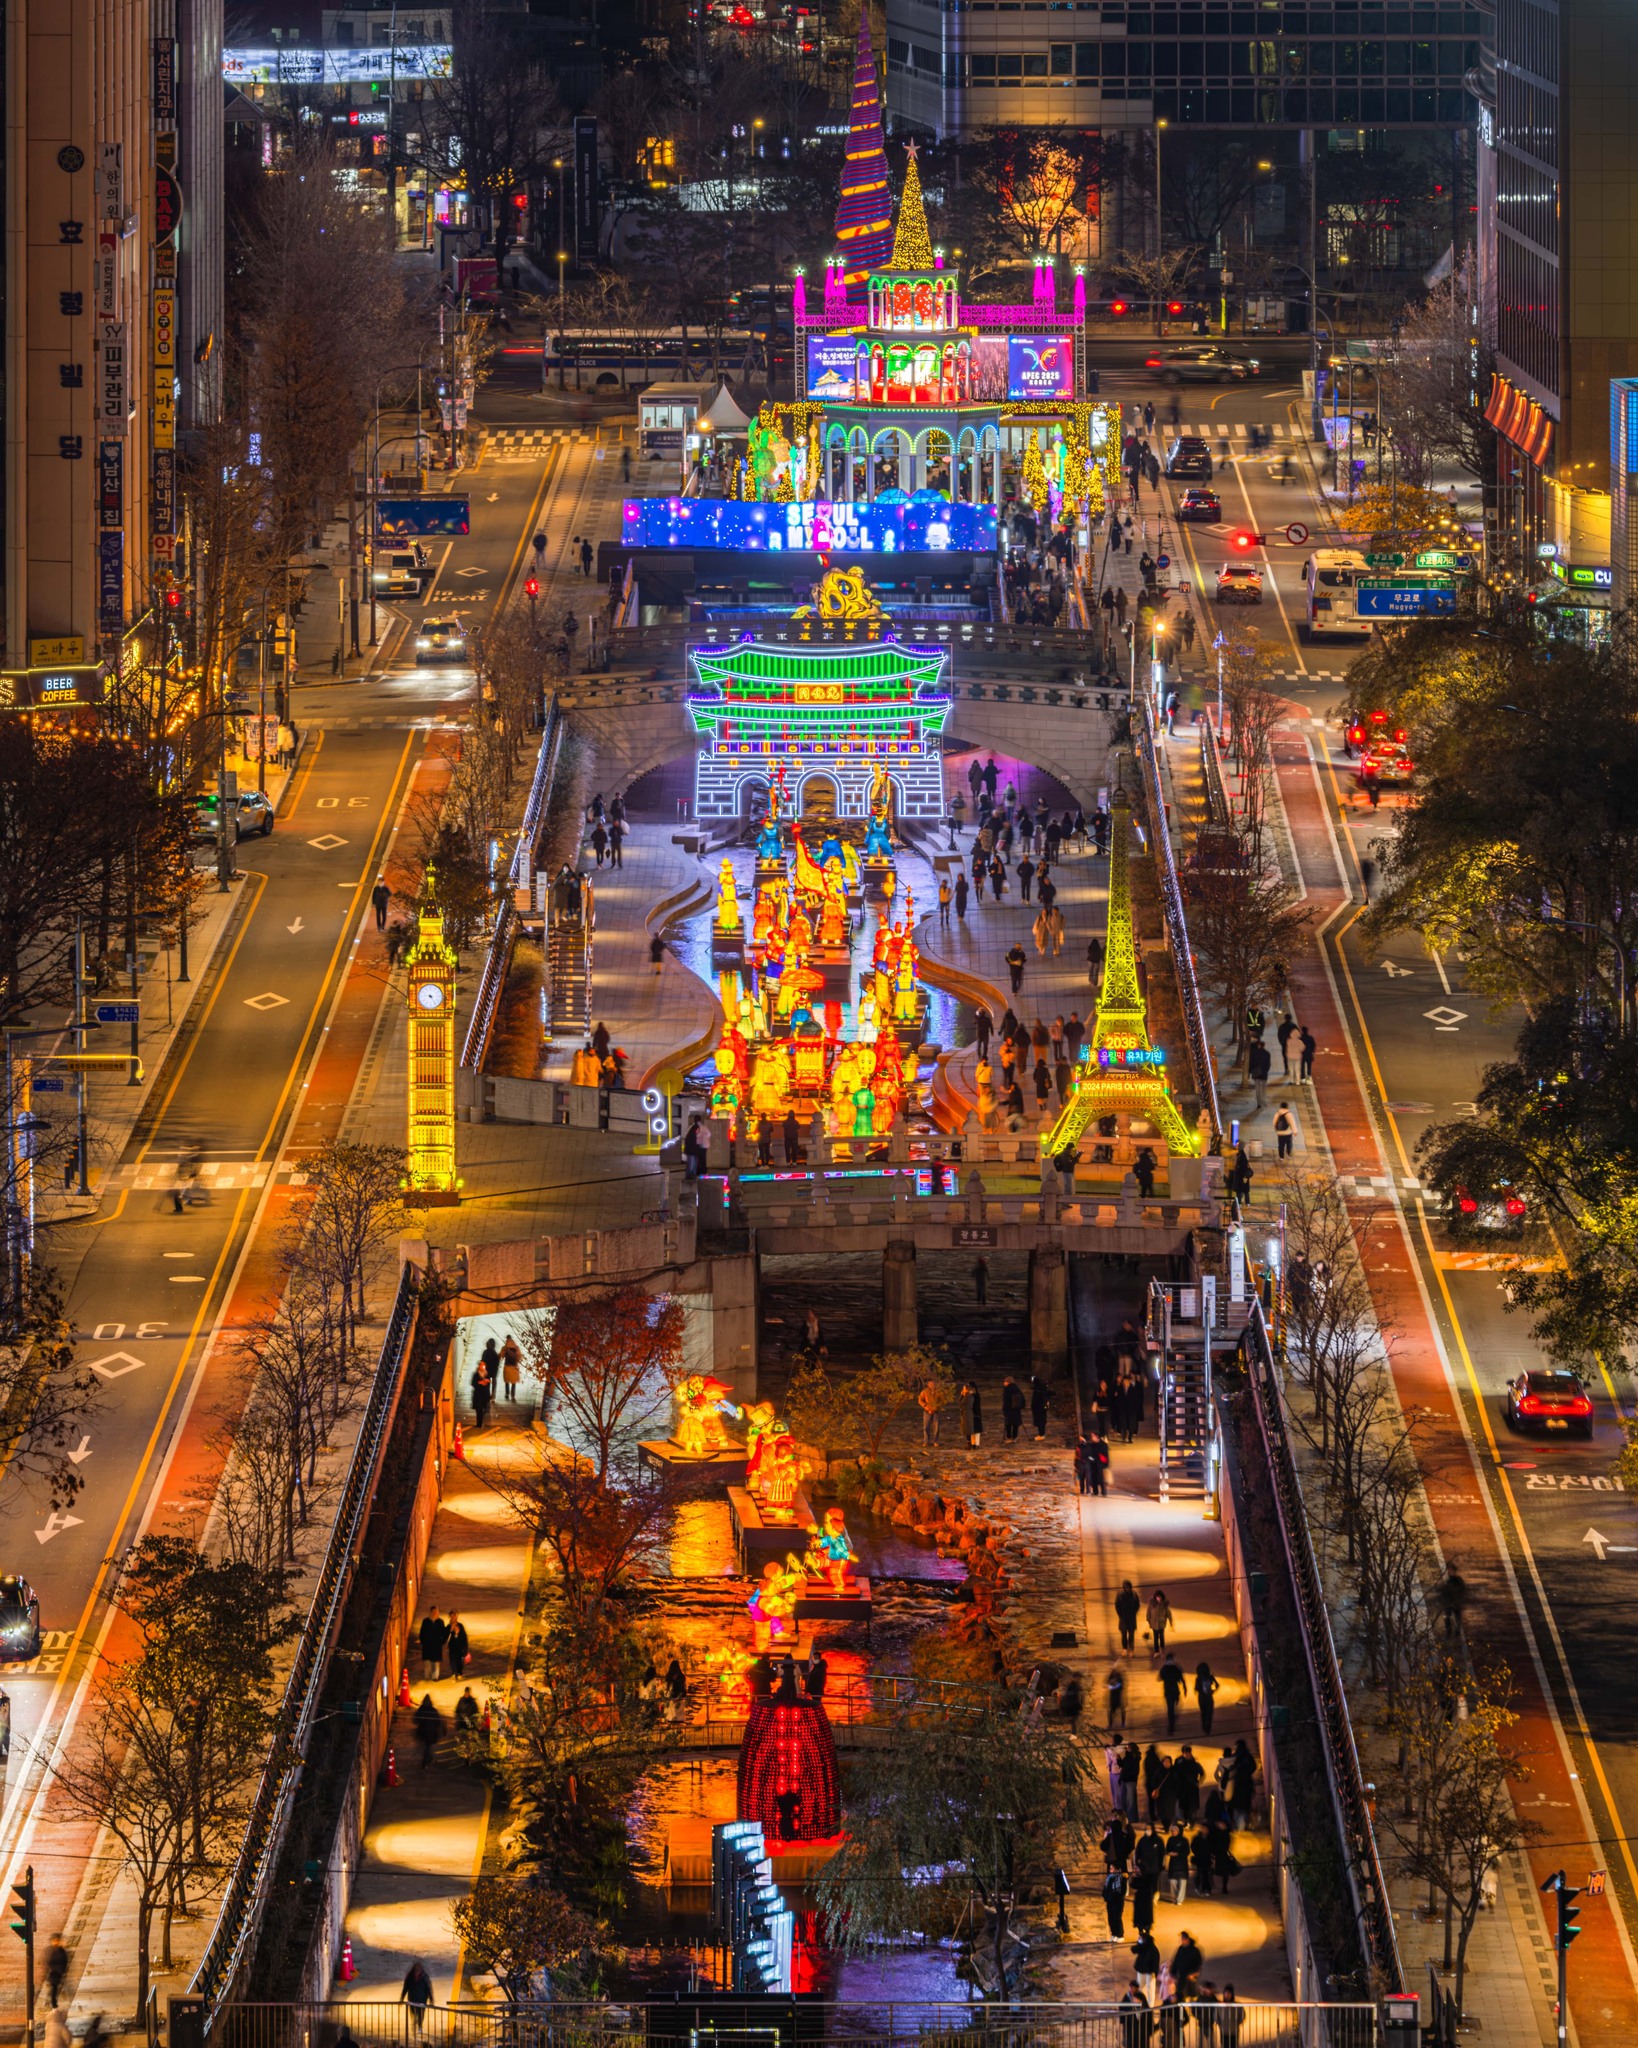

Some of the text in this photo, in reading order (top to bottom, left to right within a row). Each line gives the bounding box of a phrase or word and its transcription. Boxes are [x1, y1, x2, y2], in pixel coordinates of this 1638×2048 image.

[158, 54, 173, 109] 서린치과
[106, 170, 119, 218] 한의원
[156, 180, 172, 231] BAR
[158, 302, 171, 354] 당구클럽
[104, 346, 123, 417] 피부관리
[1022, 372, 1060, 380] APEC 2025
[156, 377, 172, 429] 고바우
[156, 490, 171, 522] 내과
[1595, 570, 1612, 583] CU
[1394, 594, 1420, 602] 무교로
[1389, 603, 1425, 611] Mugyo-ro
[38, 641, 79, 656] 고바우
[46, 678, 73, 690] BEER
[42, 689, 77, 702] COFFEE
[1106, 1037, 1137, 1049] 2036
[1081, 1051, 1162, 1063] 서울 올림픽 유치 기원
[1082, 1082, 1161, 1091] 2024 PARIS OLYMPICS
[92, 1321, 169, 1341] 30
[1524, 1473, 1625, 1492] 천천히
